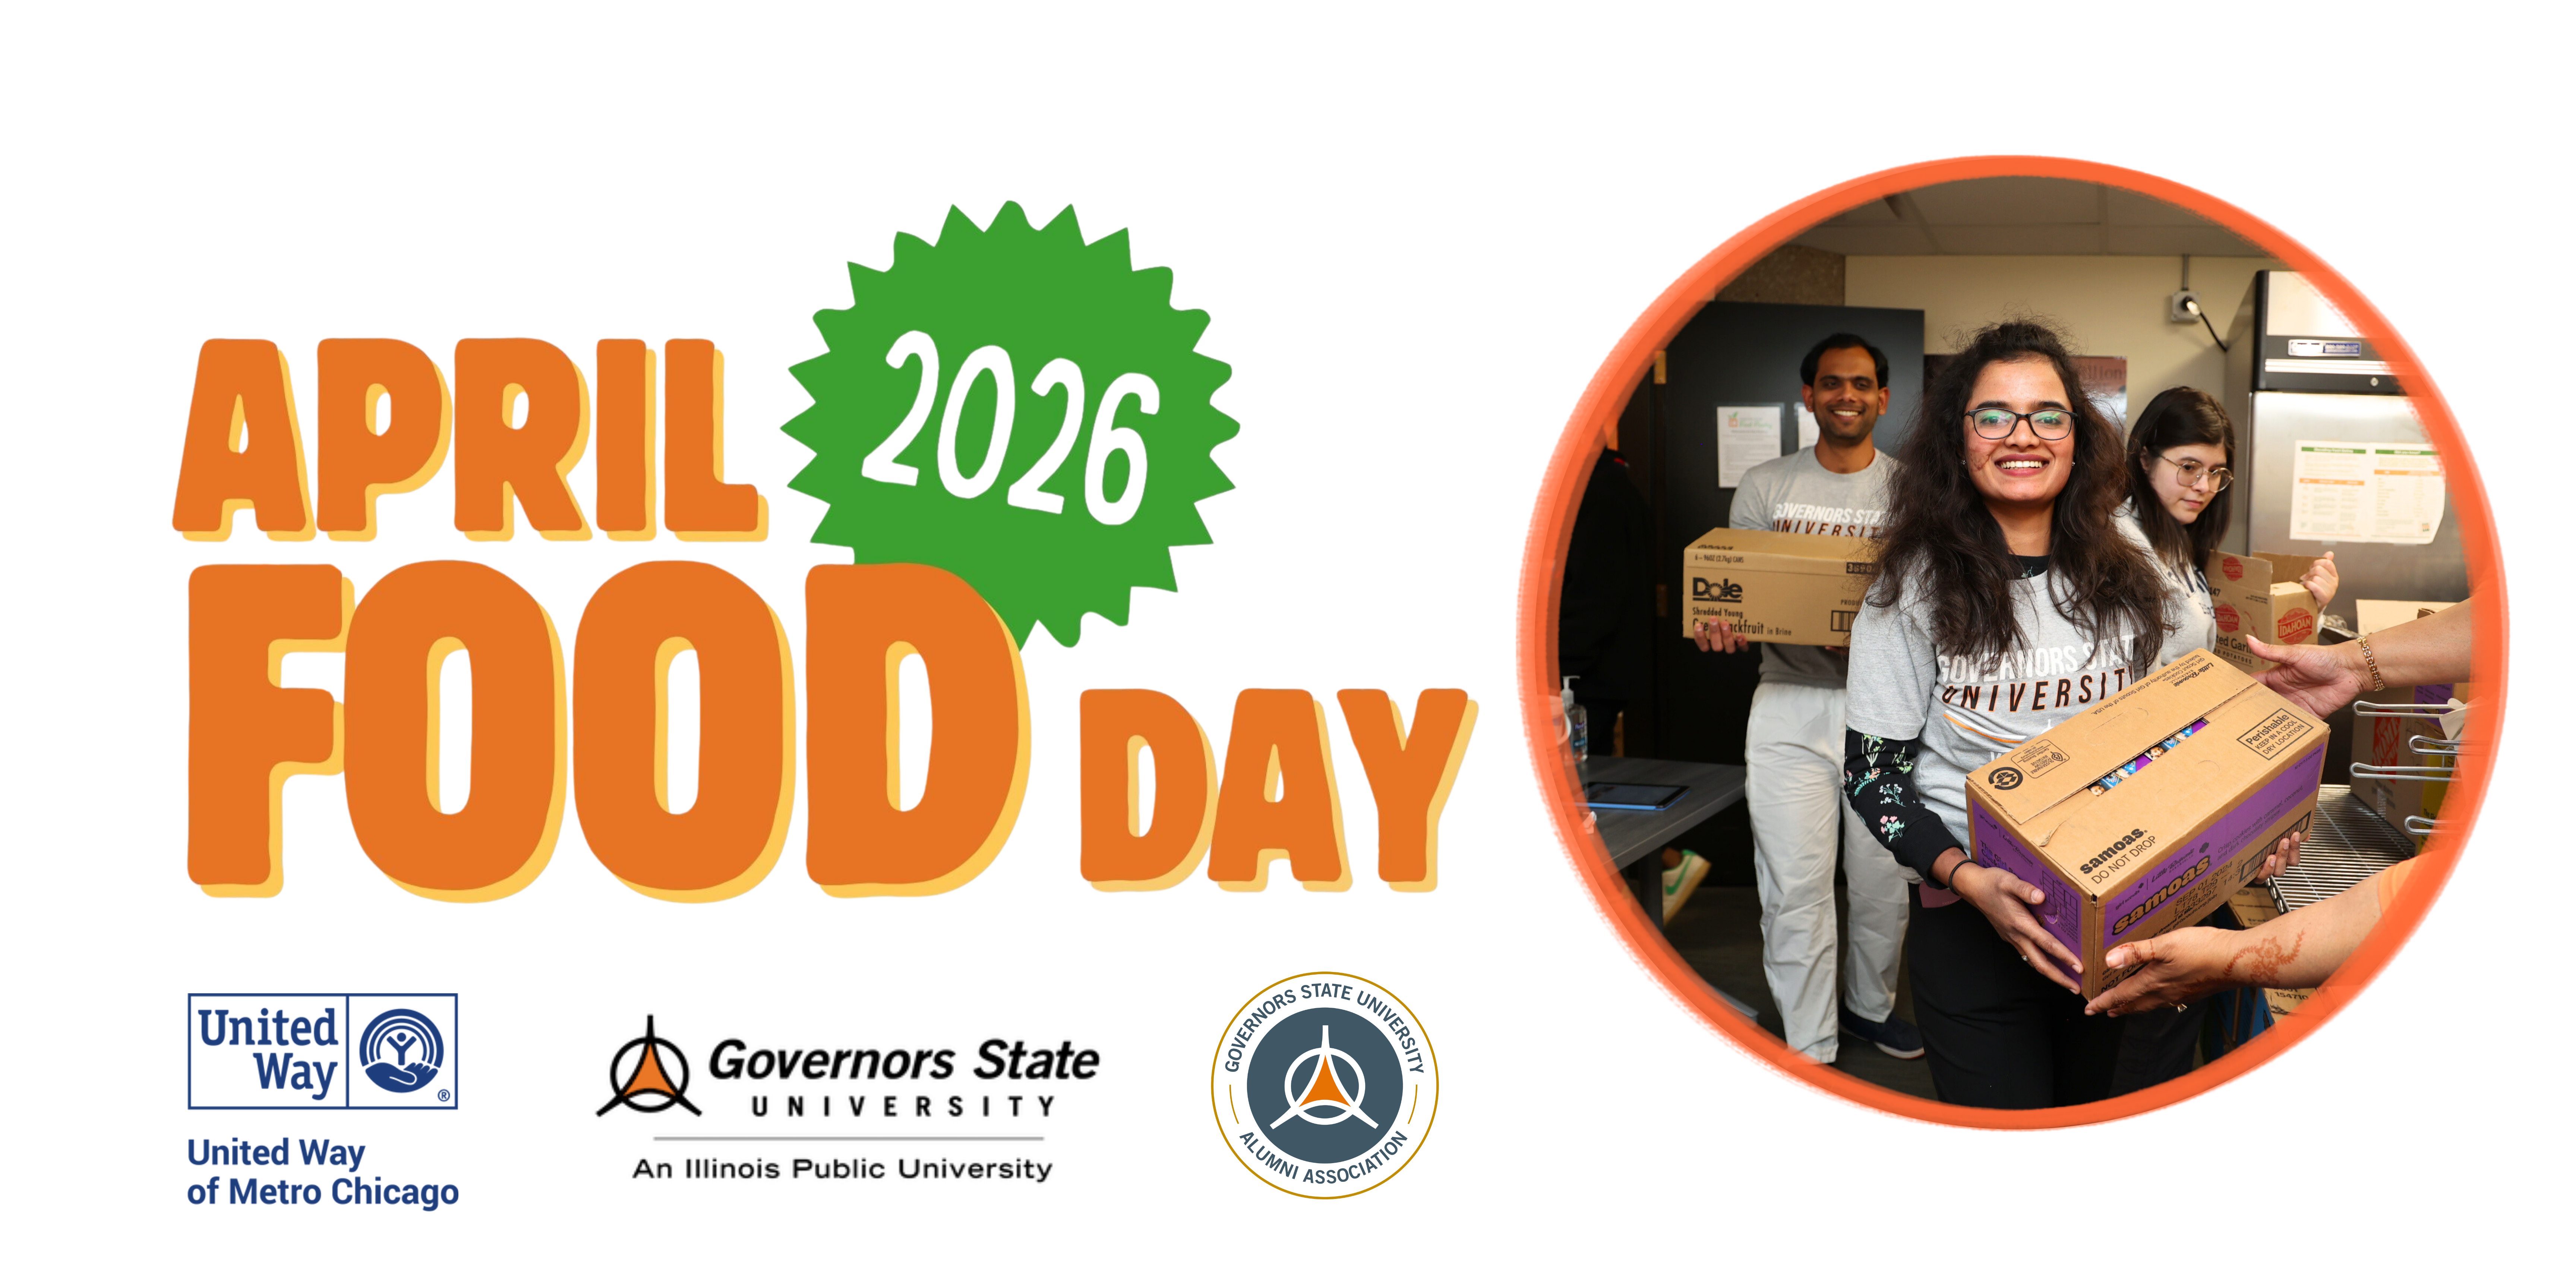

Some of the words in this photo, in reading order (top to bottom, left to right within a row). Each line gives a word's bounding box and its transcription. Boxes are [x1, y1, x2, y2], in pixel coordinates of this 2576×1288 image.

[1772, 502, 1853, 524] GOVERNORS
[1853, 509, 1887, 525] STA
[1772, 519, 1881, 537] UNIVERSIT
[1692, 577, 1743, 600] Dole
[1692, 607, 1722, 617] Shredded
[1724, 608, 1743, 619] Young
[1729, 618, 1764, 634] ckfruit
[1775, 628, 1791, 636] Brine
[2279, 617, 2311, 638] IDAHOAN
[2216, 634, 2229, 647] ted
[2231, 638, 2251, 654] Garli
[1938, 645, 2078, 683] GOVERNORS
[2083, 635, 2134, 670] STAT
[2182, 662, 2197, 671] Scout
[2185, 654, 2200, 664] baked
[2222, 651, 2252, 664] POTATOES
[2150, 670, 2172, 683] authority
[2198, 662, 2214, 673] Little
[2173, 669, 2200, 687] Brownie
[1942, 665, 2133, 712] UNIVERSIT
[2118, 690, 2137, 700] Scouts
[2245, 714, 2289, 745] Perishable
[2255, 738, 2270, 750] KEEP
[2280, 720, 2298, 732] COOL
[2263, 744, 2276, 755] DRY
[2275, 724, 2305, 746] LOCATION
[2030, 755, 2048, 766] INITIATIVE
[2037, 748, 2049, 756] Certified
[2030, 759, 2055, 774] SUSTAINABLE
[2034, 757, 2051, 768] FORESTRY
[2217, 840, 2232, 853] Crisp
[2232, 825, 2251, 841] cookies
[2252, 817, 2263, 827] with
[2263, 800, 2283, 819] caramel,
[2284, 785, 2304, 803] coconut,
[2002, 834, 2014, 847] Little
[2217, 849, 2228, 861] and
[2228, 842, 2240, 855] dark
[2241, 825, 2264, 844] chocolaty
[2264, 810, 2280, 824] stripes
[1980, 840, 1993, 856] The
[2080, 828, 2144, 874] samoas
[2091, 870, 2109, 884] DO
[2108, 854, 2131, 872] NOT
[2129, 836, 2156, 857] DROP
[2151, 868, 2168, 883] Little
[2168, 848, 2195, 869] Brownie
[2176, 888, 2195, 906] SEP
[2198, 878, 2208, 890] 01
[2211, 861, 2232, 881] 2024
[2112, 854, 2211, 936] samoas
[2115, 901, 2125, 911] girl
[2125, 890, 2140, 904] scouts
[2182, 894, 2198, 909] 178
[2202, 879, 2218, 894] T29
[2101, 975, 2121, 993] NOT
[2274, 991, 2309, 1000] 154710
